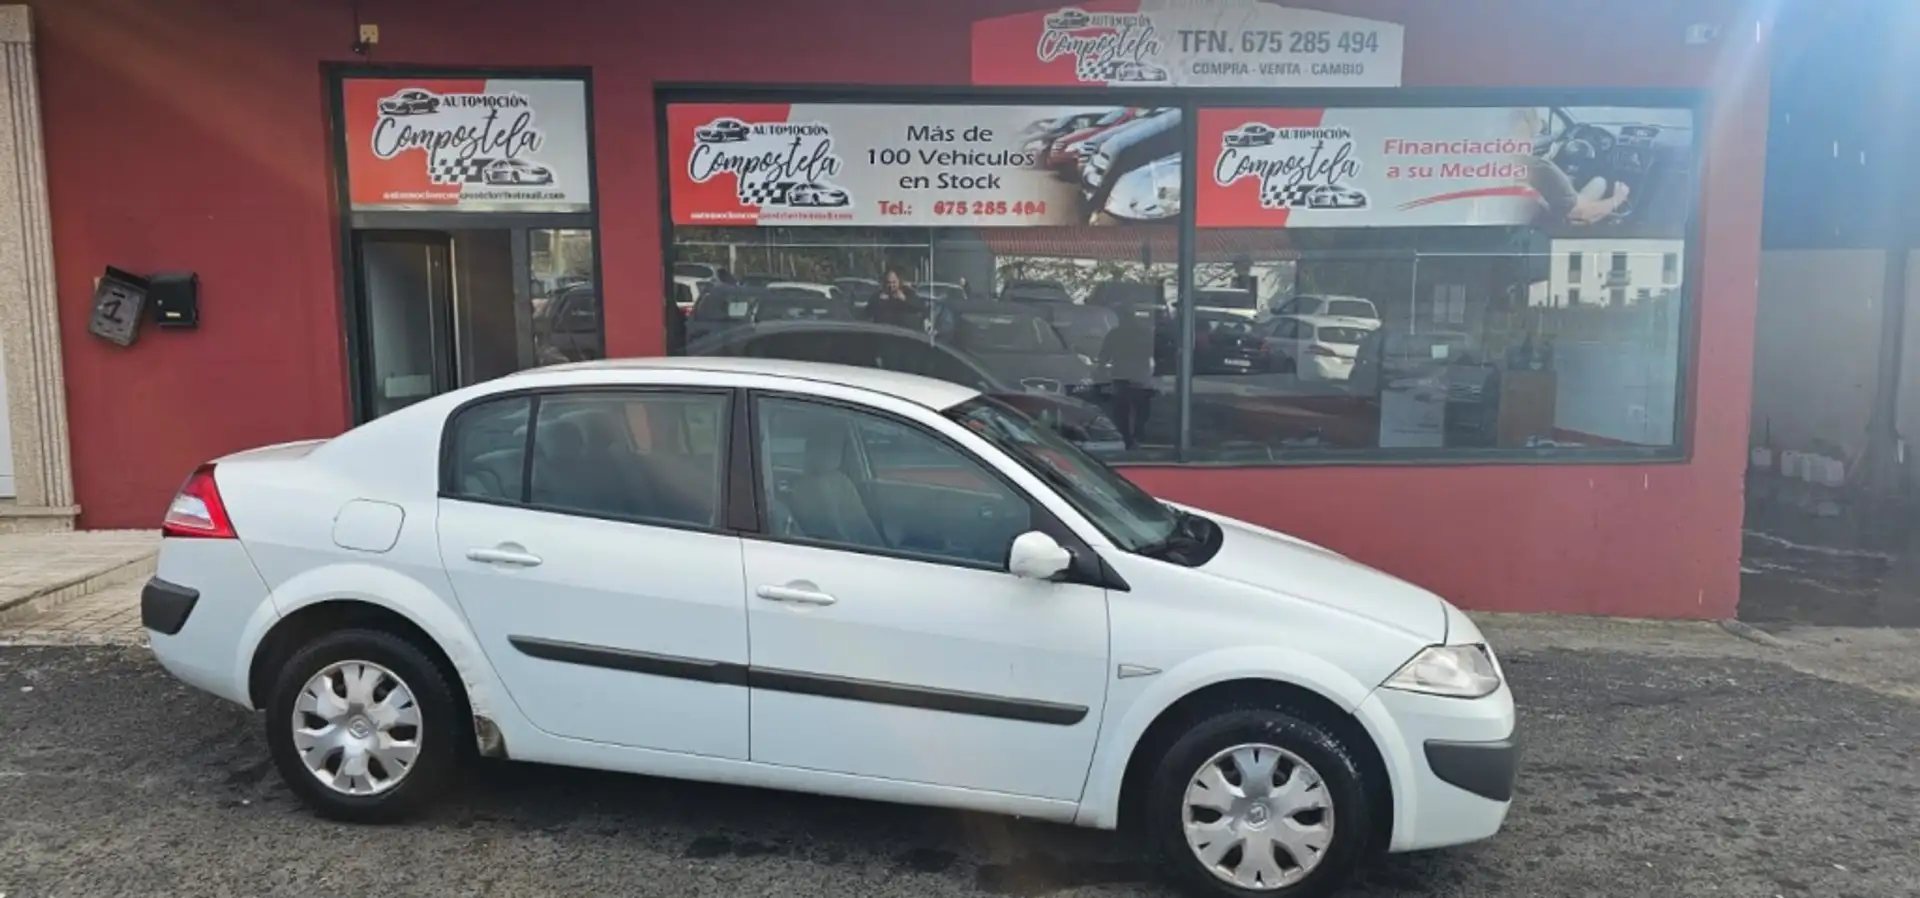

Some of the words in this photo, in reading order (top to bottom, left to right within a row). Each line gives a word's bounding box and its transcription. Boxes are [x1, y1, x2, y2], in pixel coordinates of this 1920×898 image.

[1040, 24, 1161, 68] Compostela
[1178, 30, 1233, 54] TFN.
[1241, 30, 1283, 54] 675
[1289, 30, 1330, 54] 285
[1337, 30, 1379, 54] 494
[1192, 62, 1248, 76] COMPRA
[1259, 62, 1300, 76] VENTA
[1311, 62, 1364, 76] CAMBIO
[441, 94, 529, 108] AUTOMOCIÓN
[752, 123, 829, 136] AUTOMOCIÓN
[907, 125, 955, 142] Más
[963, 125, 993, 142] de
[1278, 127, 1351, 139] AUTOMOCIÓN
[374, 109, 543, 168] Compostela
[1384, 138, 1532, 155] Financiación
[690, 137, 842, 192] Compostela
[868, 149, 911, 165] 100
[1217, 140, 1361, 193] Compostela
[1386, 165, 1400, 179] a
[1407, 165, 1433, 179] su
[1440, 161, 1528, 179] Medida
[899, 175, 930, 189] en
[937, 172, 1001, 189] Stock
[878, 200, 912, 216] Tel.:
